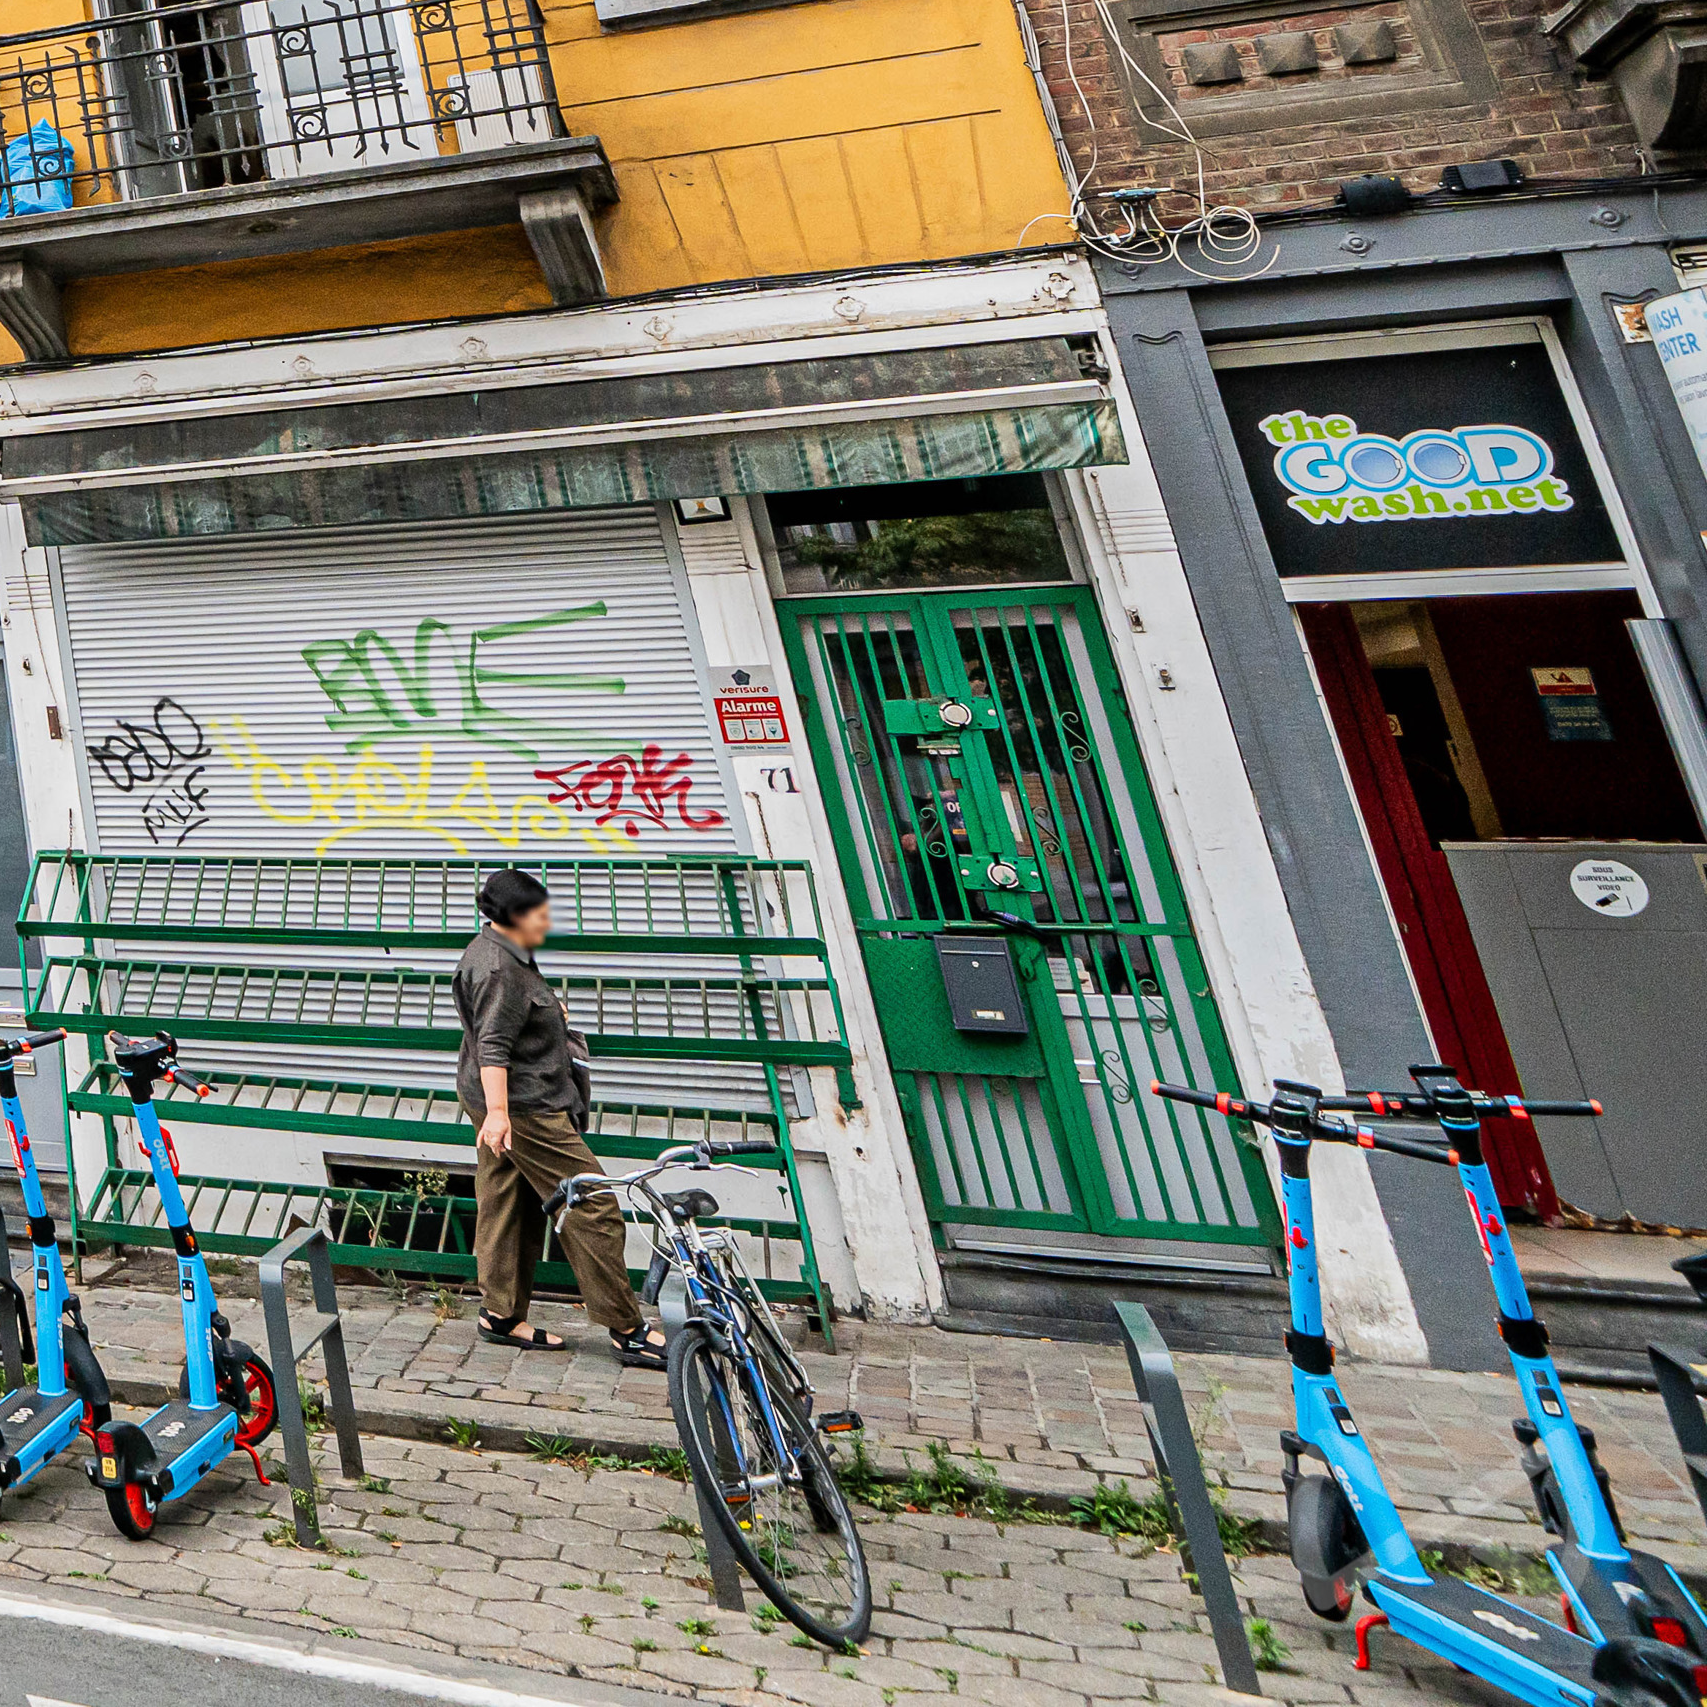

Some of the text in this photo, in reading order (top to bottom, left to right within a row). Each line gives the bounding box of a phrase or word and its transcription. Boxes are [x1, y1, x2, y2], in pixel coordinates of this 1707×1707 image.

[1265, 414, 1353, 443] the
[1284, 431, 1543, 494] GOOD
[1294, 478, 1567, 522] wash.net
[719, 685, 770, 694] verisure
[721, 699, 777, 713] Alarme
[759, 766, 801, 794] 71
[153, 1138, 172, 1172] dott
[1335, 1464, 1364, 1513] dott
